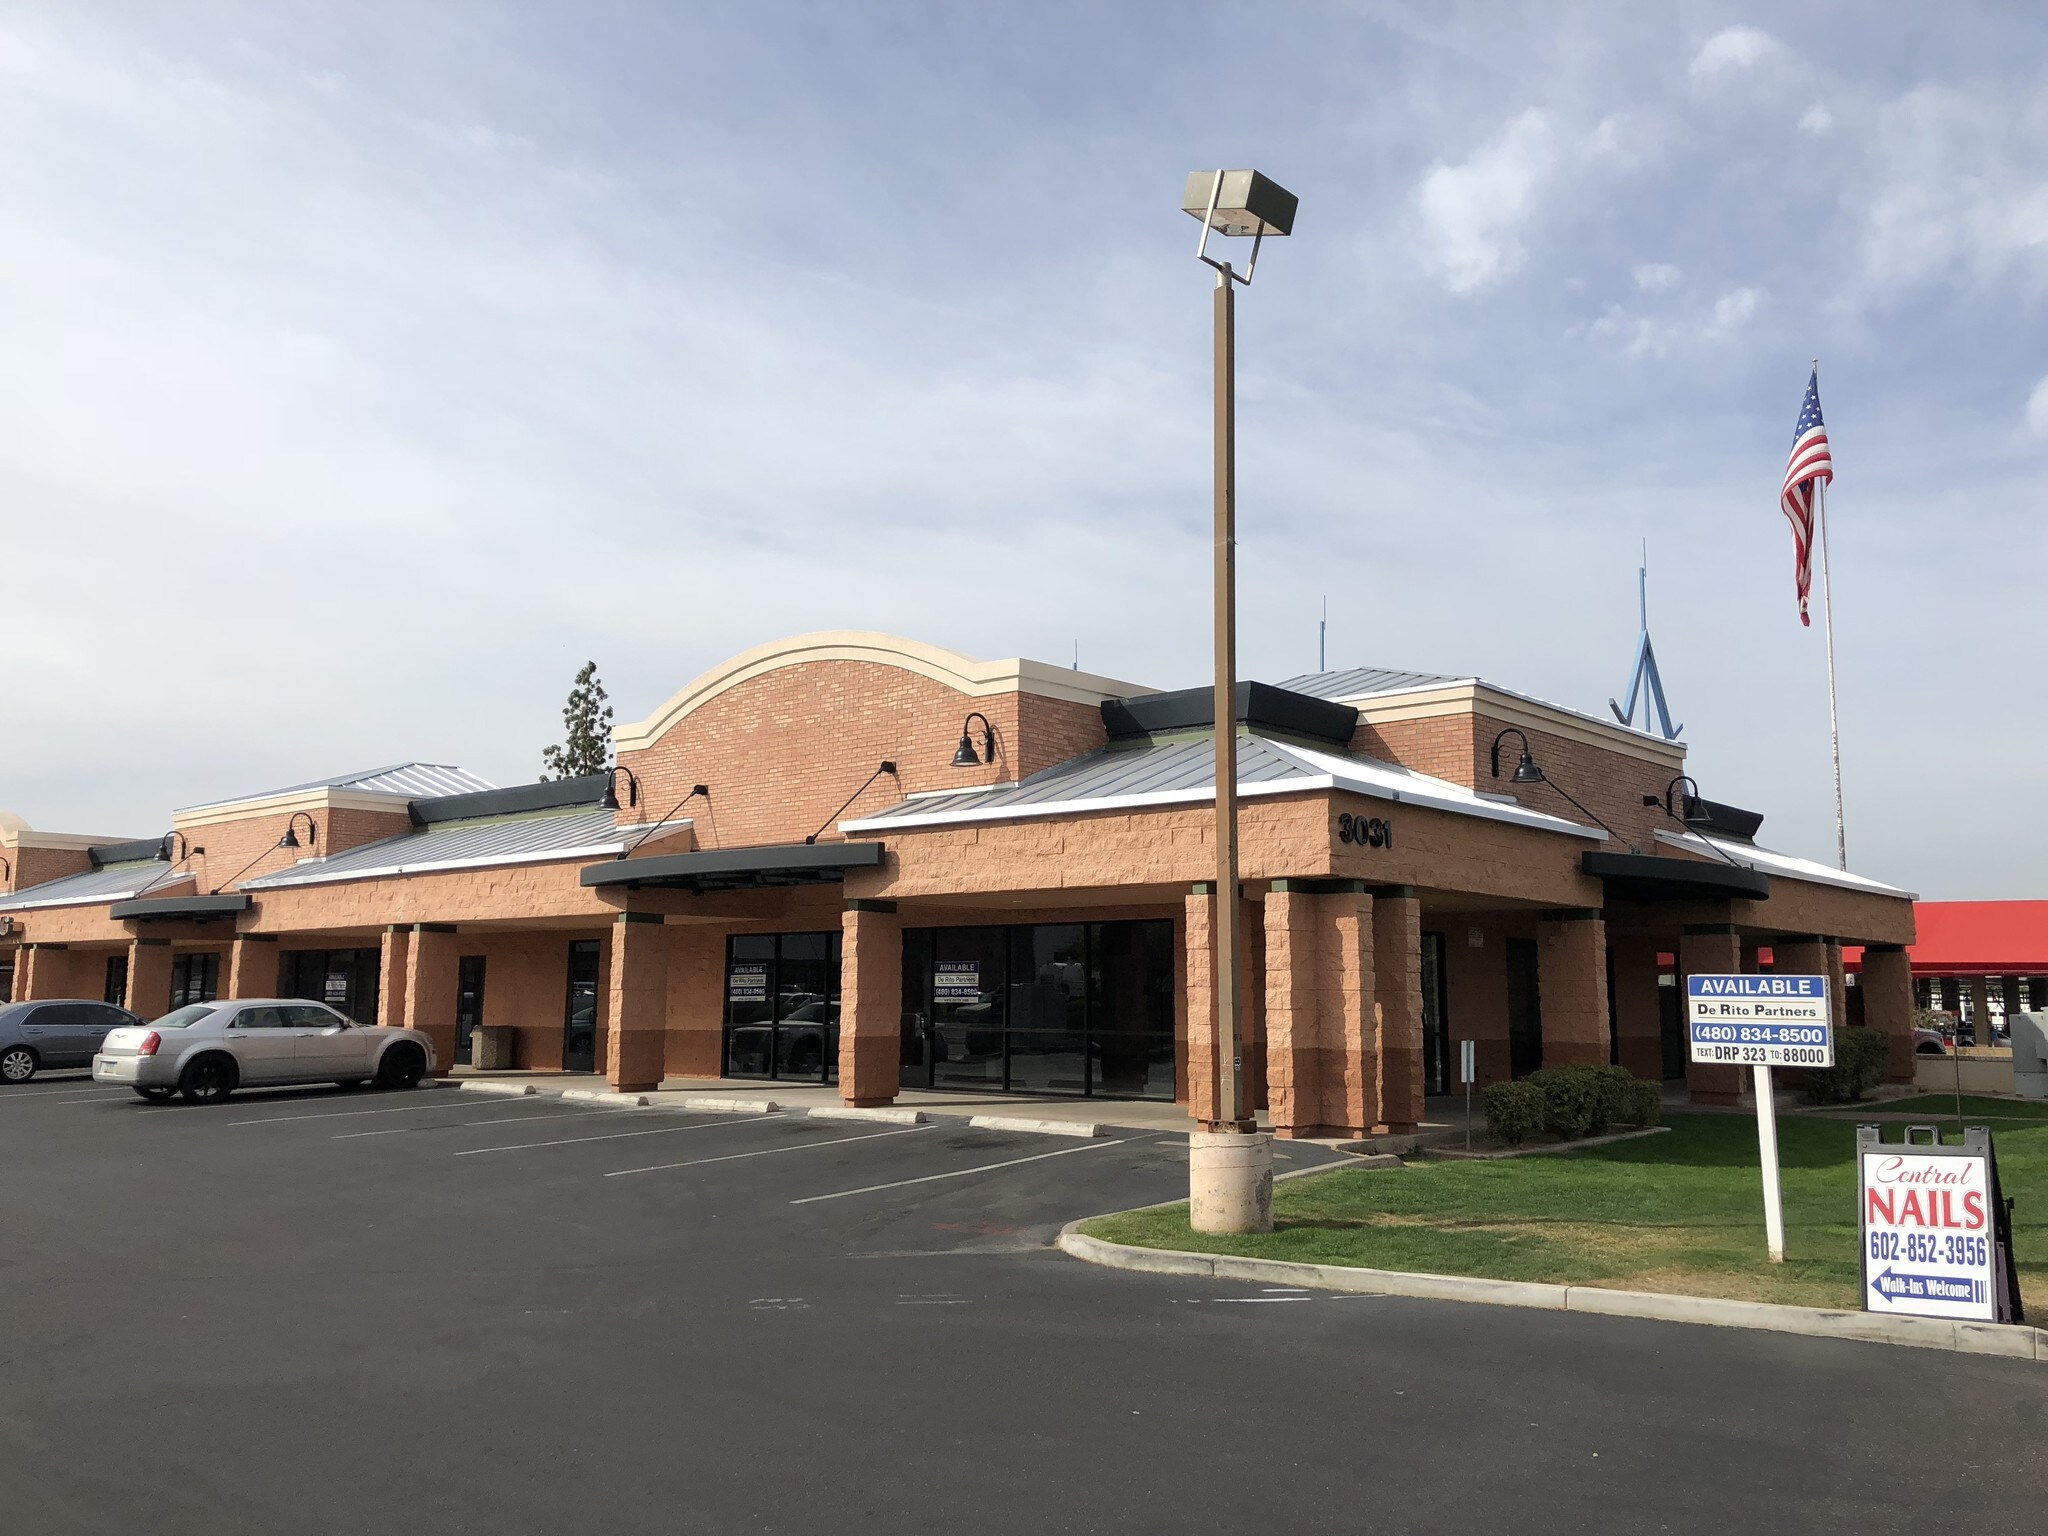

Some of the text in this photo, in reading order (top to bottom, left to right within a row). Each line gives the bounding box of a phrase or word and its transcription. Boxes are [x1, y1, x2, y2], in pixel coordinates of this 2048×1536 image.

[1339, 812, 1393, 849] 3031
[940, 964, 975, 972] AVAILABLE
[1700, 979, 1812, 995] AVAILABLE
[1698, 1003, 1817, 1017] De Rito Partners
[1695, 1025, 1823, 1043] (480) 834-8500
[1696, 1046, 1825, 1063] TEXT: DRP 323 TO: 88000
[1876, 1156, 1973, 1185] Central
[1867, 1186, 1987, 1232] NAILS
[1870, 1231, 1987, 1267] 602-852-3956
[1880, 1276, 1972, 1298] Walk-Ins Welcome
